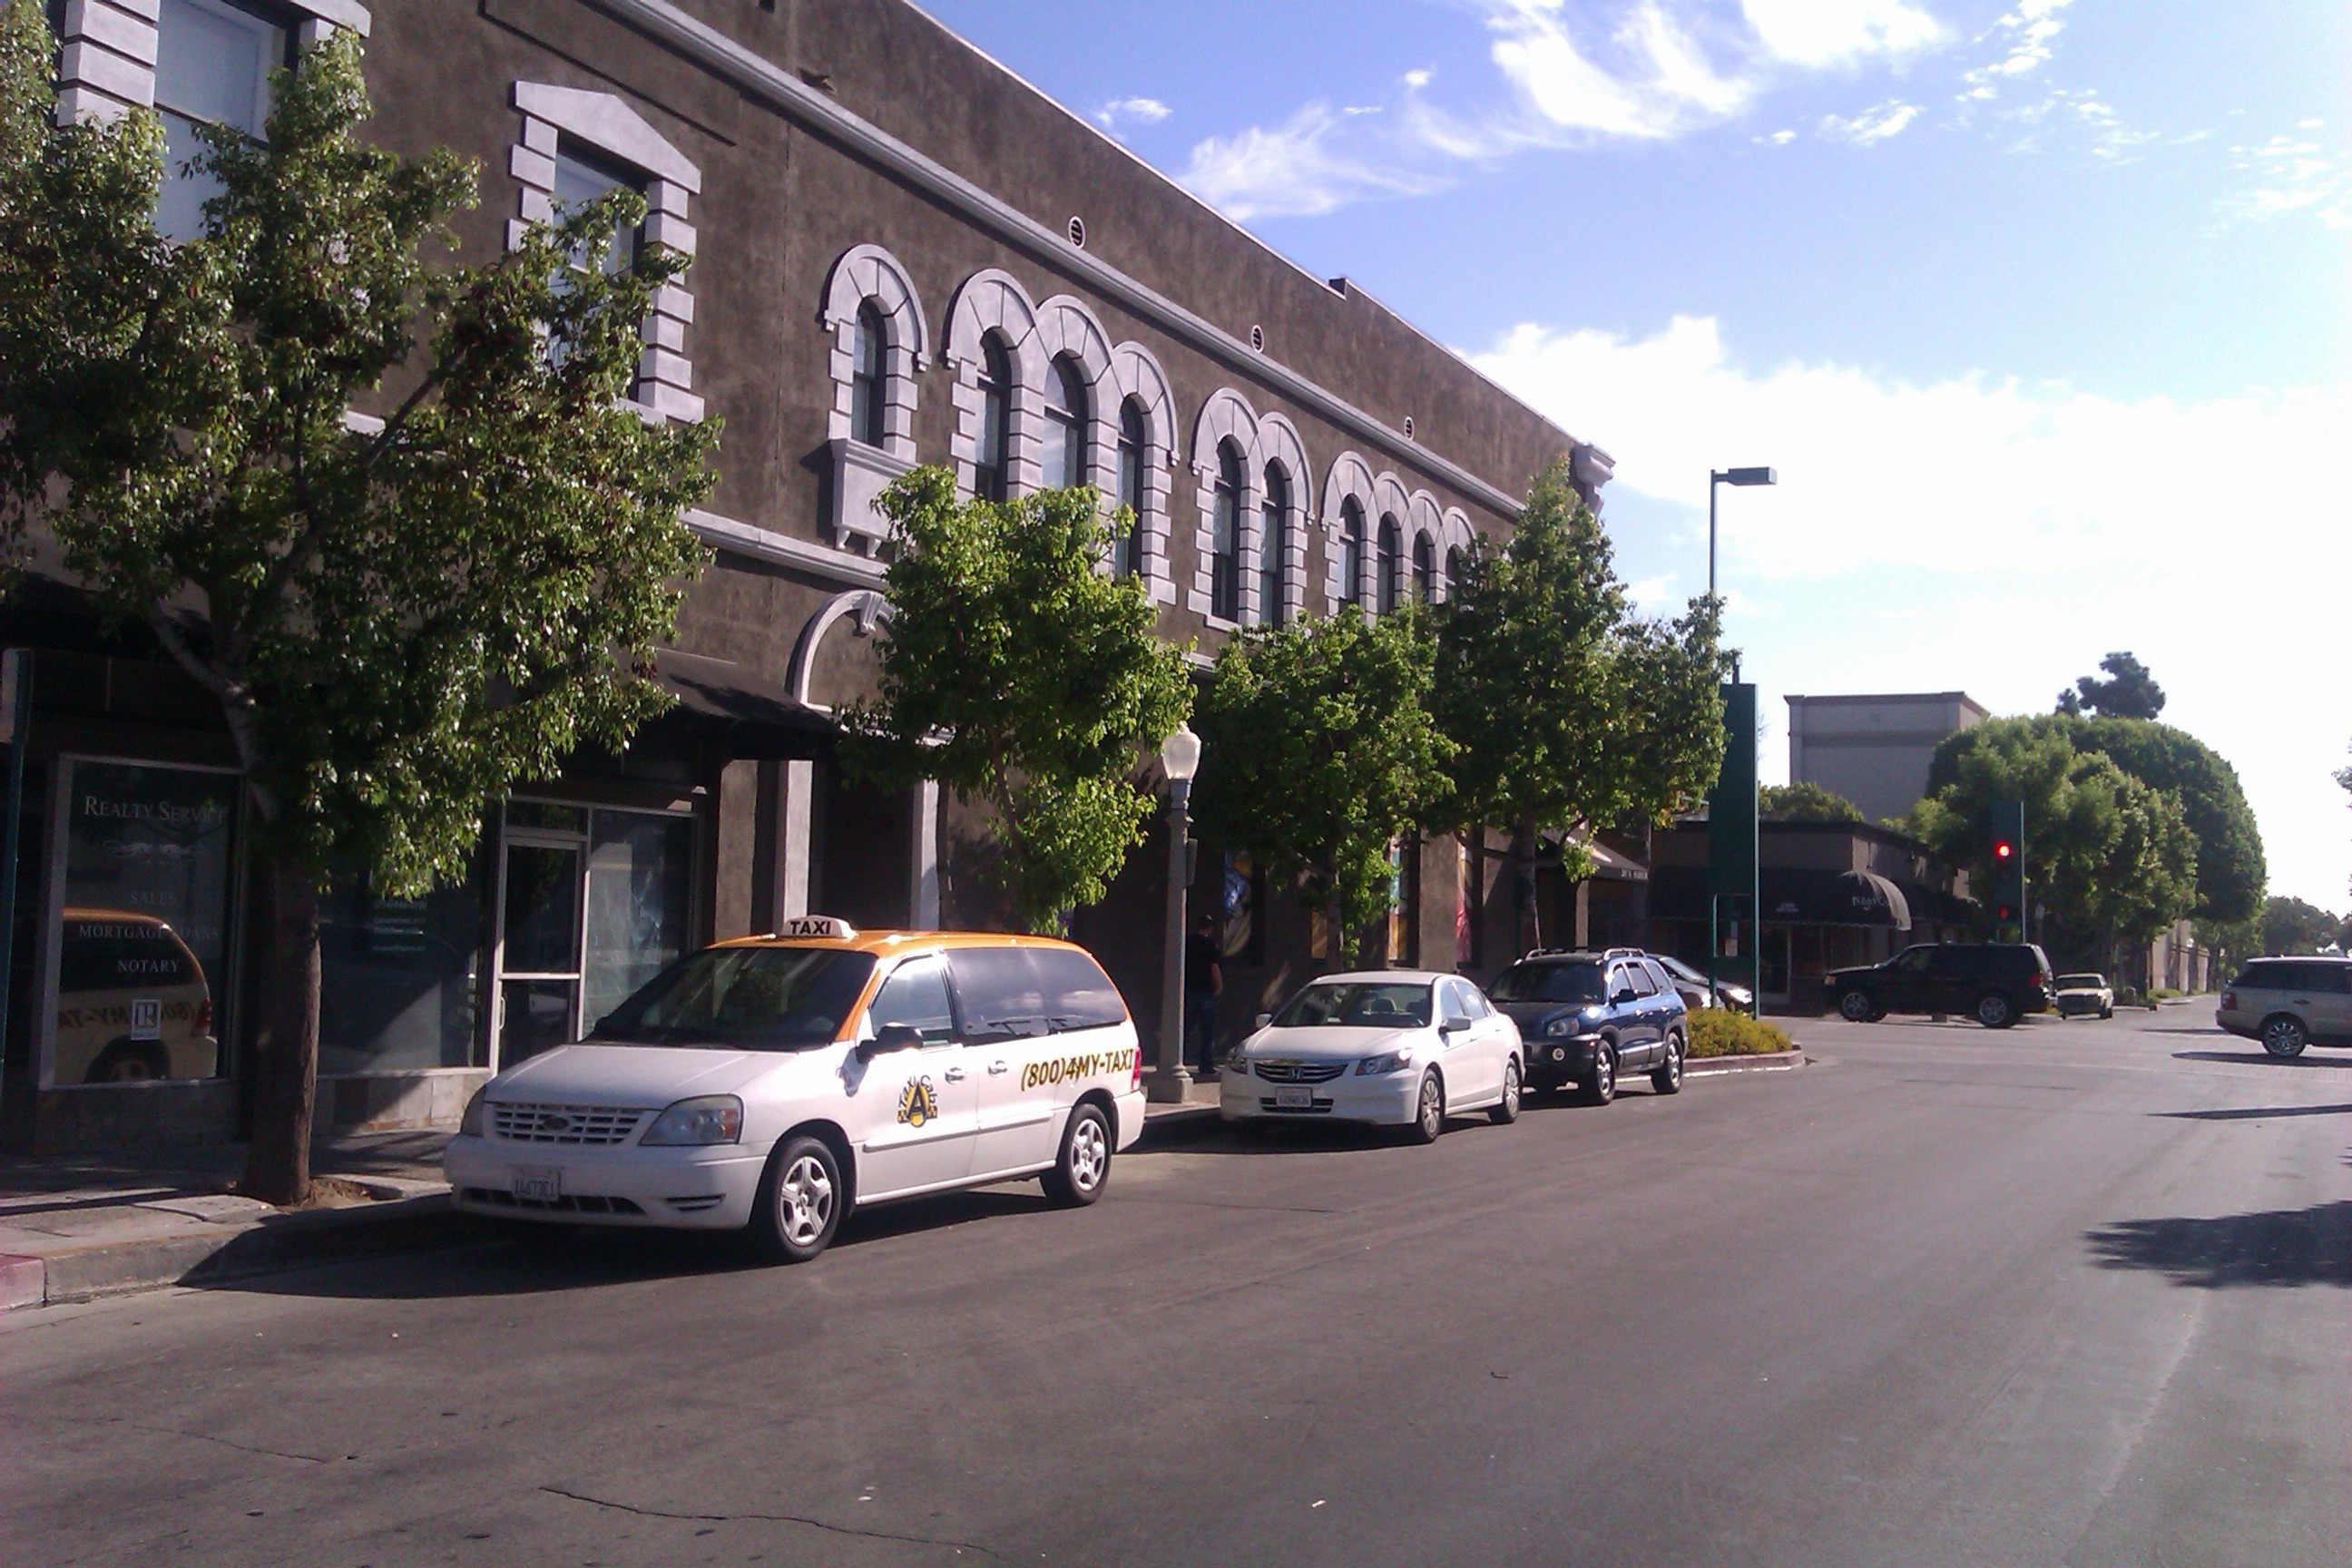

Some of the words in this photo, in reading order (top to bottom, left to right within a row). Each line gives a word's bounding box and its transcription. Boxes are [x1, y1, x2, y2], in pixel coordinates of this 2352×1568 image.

[790, 920, 831, 935] TAXI
[116, 959, 181, 973] NOTARY
[920, 1074, 937, 1104] Cab
